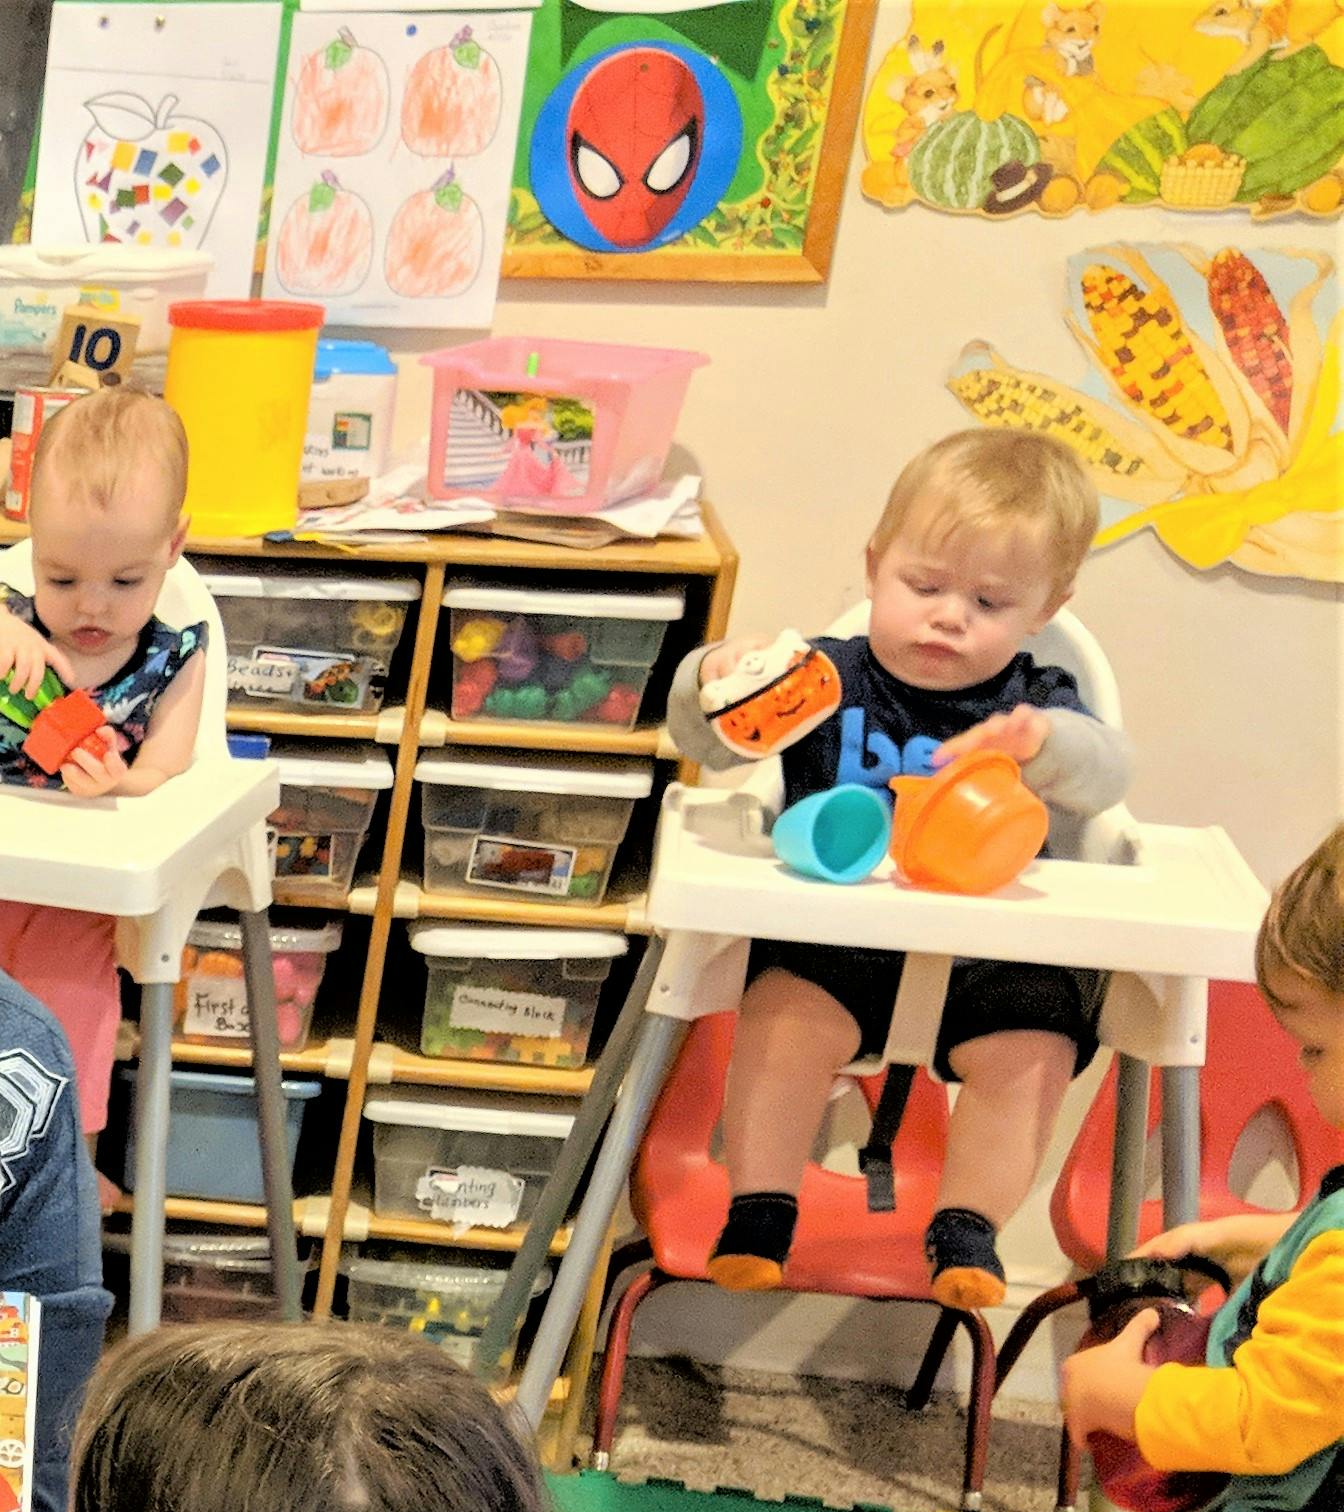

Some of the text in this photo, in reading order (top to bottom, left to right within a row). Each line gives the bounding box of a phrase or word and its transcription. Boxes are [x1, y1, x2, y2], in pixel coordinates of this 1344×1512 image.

[14, 298, 57, 316] Pampers
[69, 324, 121, 371] 10
[194, 992, 236, 1018] First
